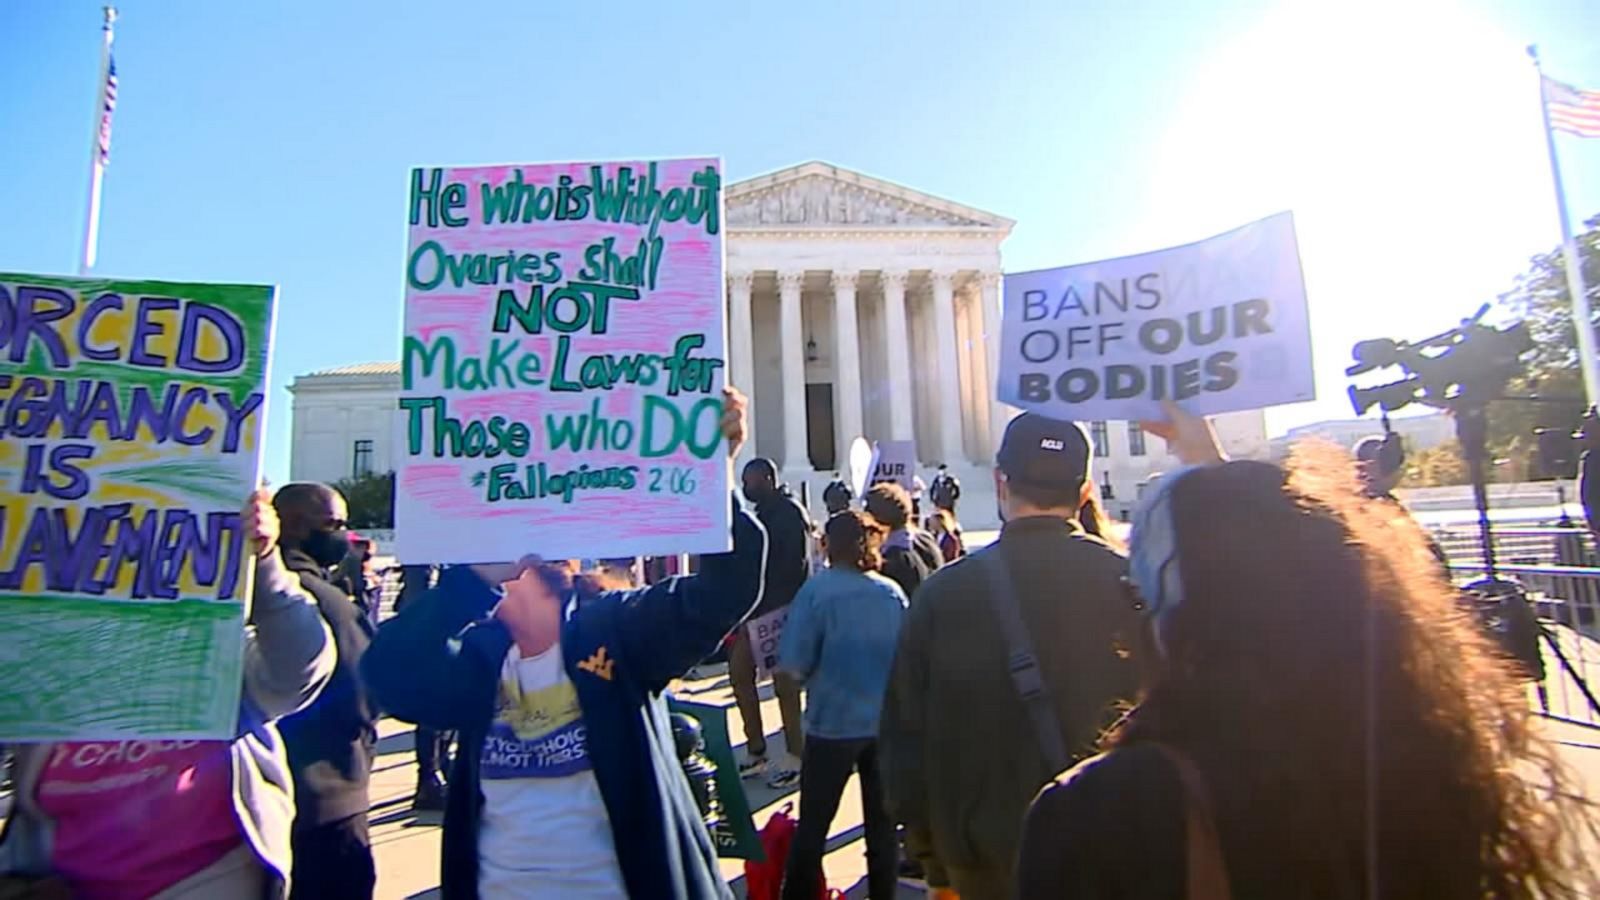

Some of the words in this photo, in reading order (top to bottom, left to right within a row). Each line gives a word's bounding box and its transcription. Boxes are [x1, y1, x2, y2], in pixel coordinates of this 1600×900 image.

[408, 167, 469, 228] He
[406, 240, 562, 291] Ovaries
[492, 281, 641, 334] NOT
[1021, 272, 1162, 322] BANS
[1019, 322, 1125, 364] OFF
[1138, 298, 1275, 355] OUR
[1018, 350, 1239, 404] BODIES
[399, 396, 531, 459] Those
[545, 397, 634, 453] who
[639, 395, 725, 460] DO
[20, 443, 95, 501] IS
